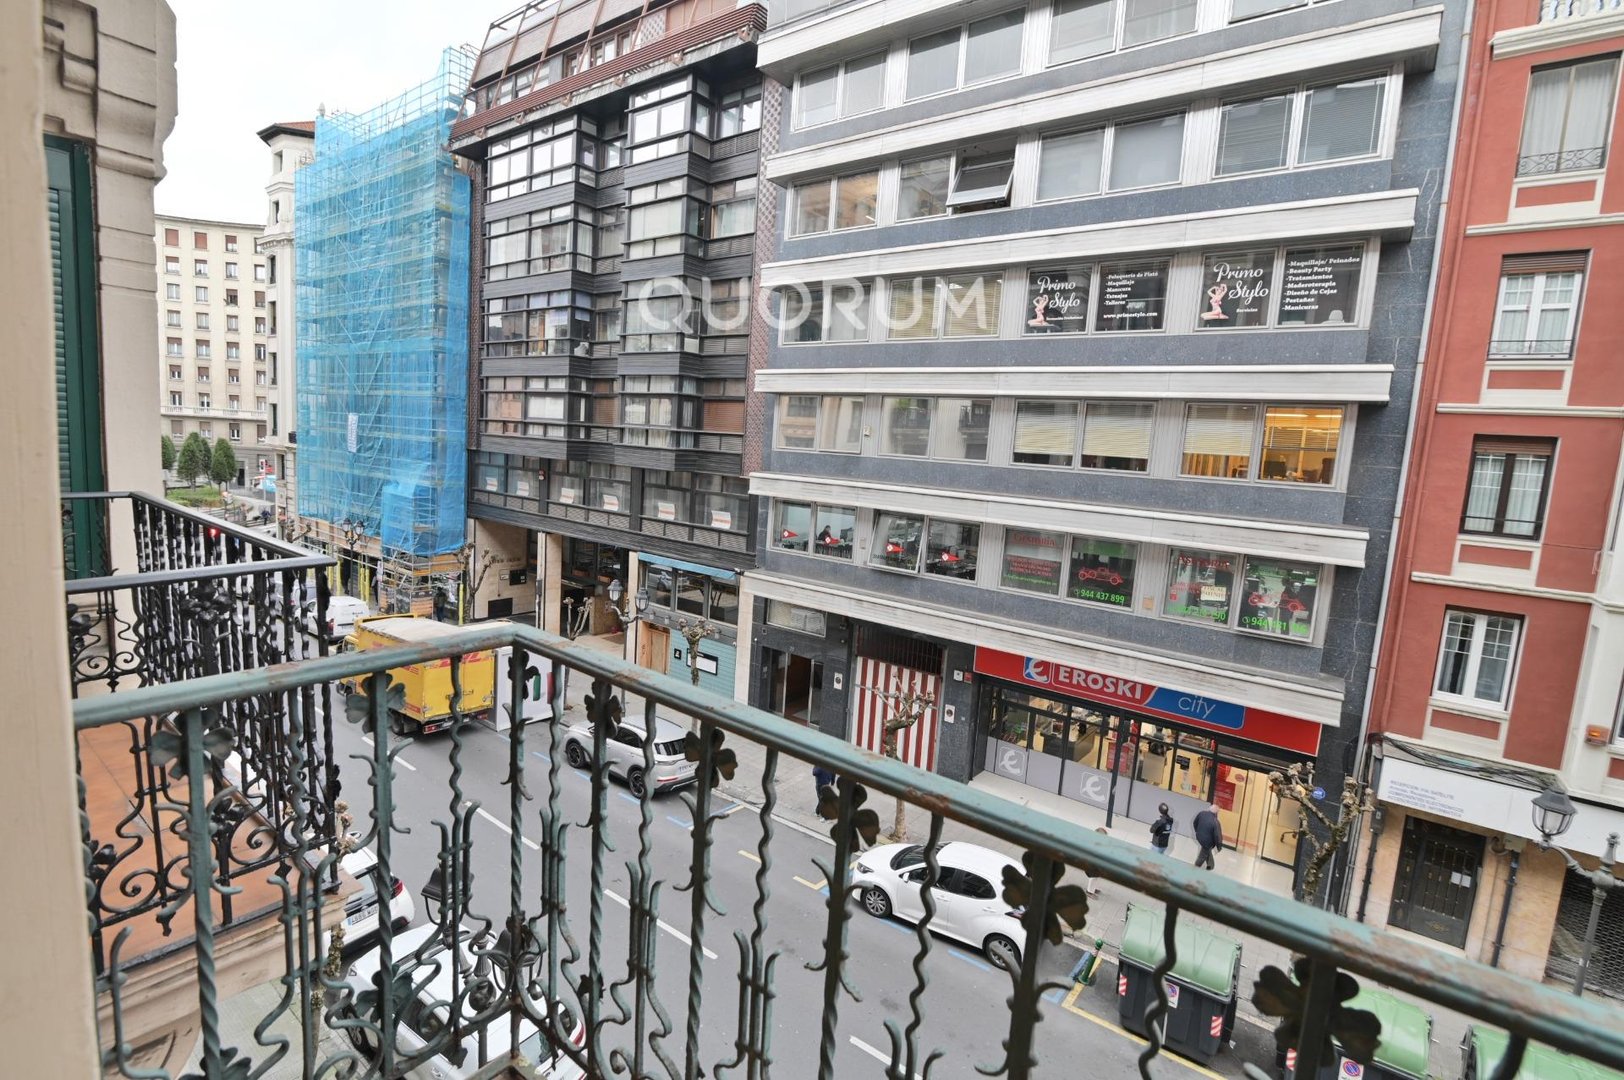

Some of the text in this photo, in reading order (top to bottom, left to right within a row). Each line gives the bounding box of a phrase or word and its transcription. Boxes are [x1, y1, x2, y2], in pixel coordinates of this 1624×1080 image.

[1329, 256, 1360, 264] Peinados
[1213, 262, 1263, 282] Primo
[1037, 275, 1076, 294] Primo
[1228, 280, 1269, 306] Stylo
[1048, 292, 1080, 314] Stylo
[1080, 589, 1125, 604] 944 437 899
[1058, 665, 1144, 700] EROSKI
[1178, 696, 1216, 720] city
